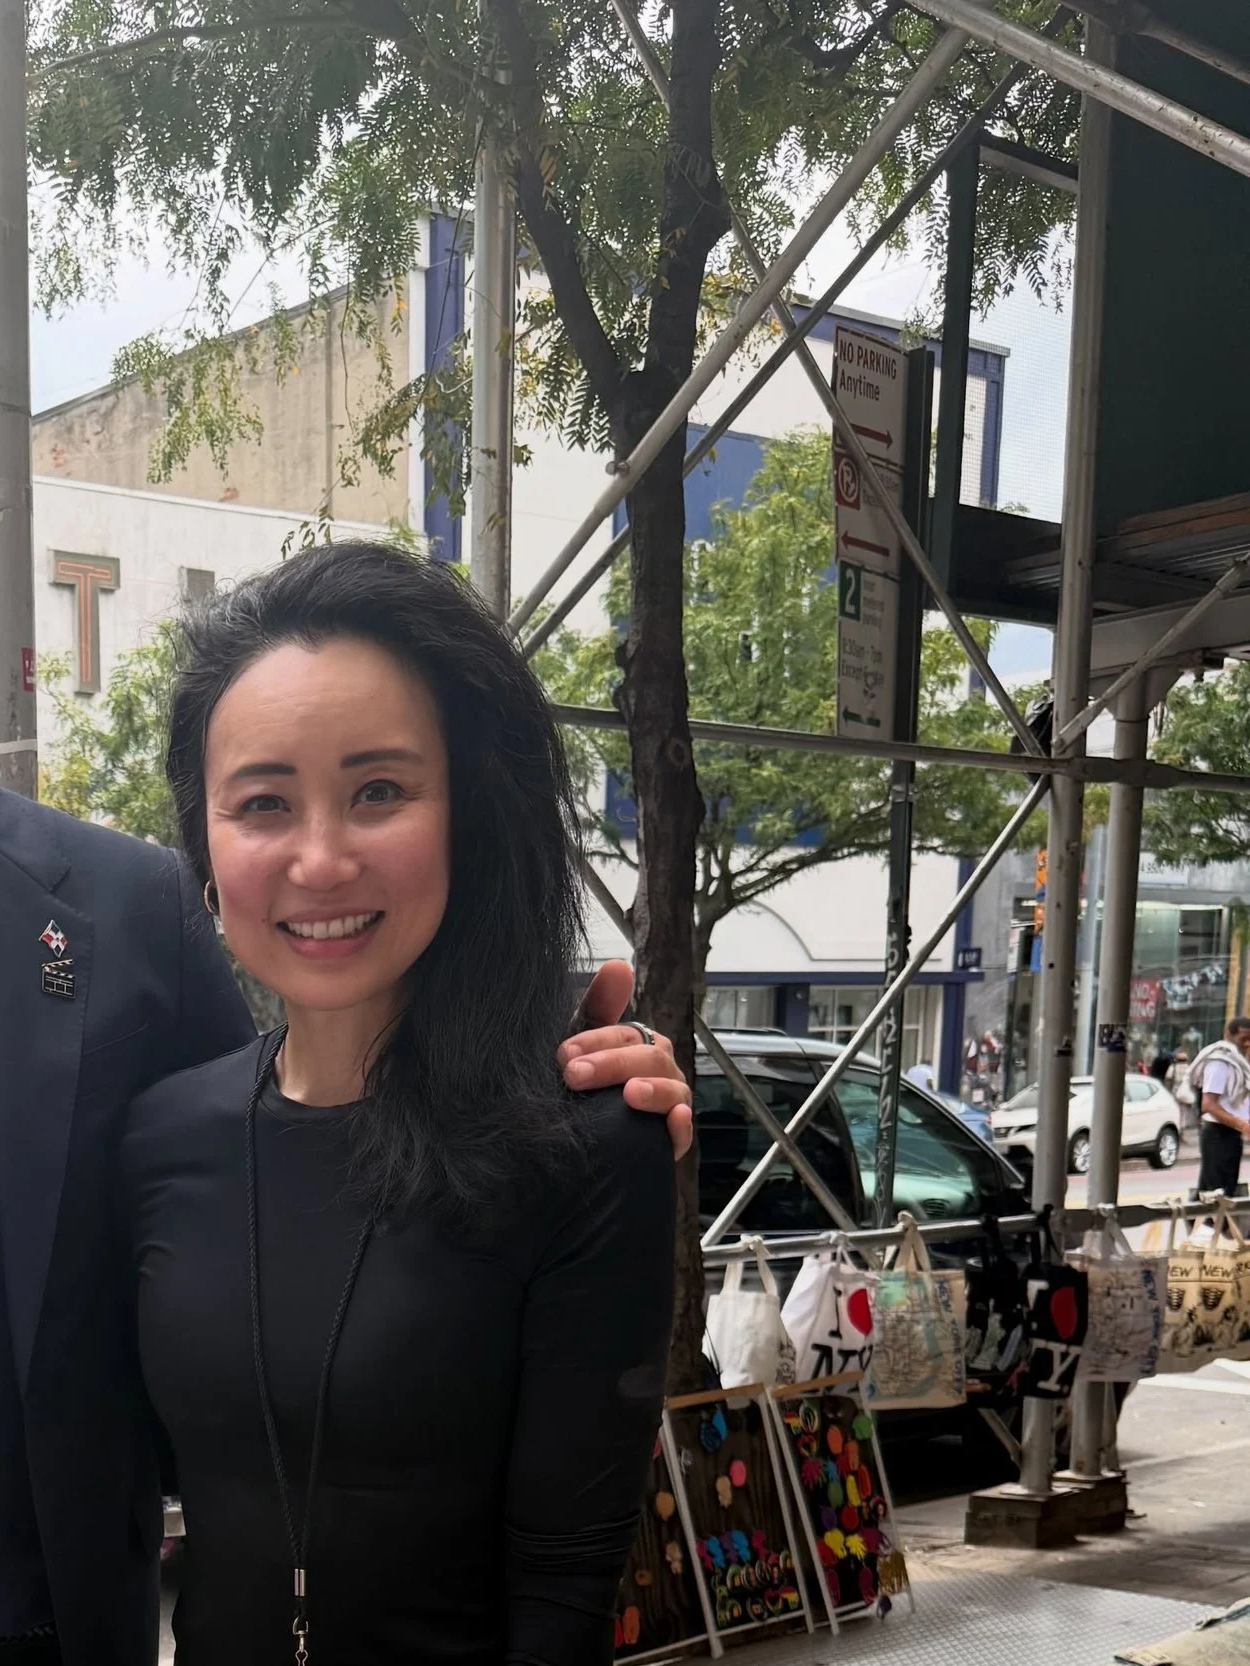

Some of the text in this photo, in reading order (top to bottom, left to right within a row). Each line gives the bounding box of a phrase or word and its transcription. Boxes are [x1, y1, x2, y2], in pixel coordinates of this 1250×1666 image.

[839, 339, 897, 380] NO PARKING
[839, 369, 880, 401] Anytime
[844, 568, 856, 614] 2
